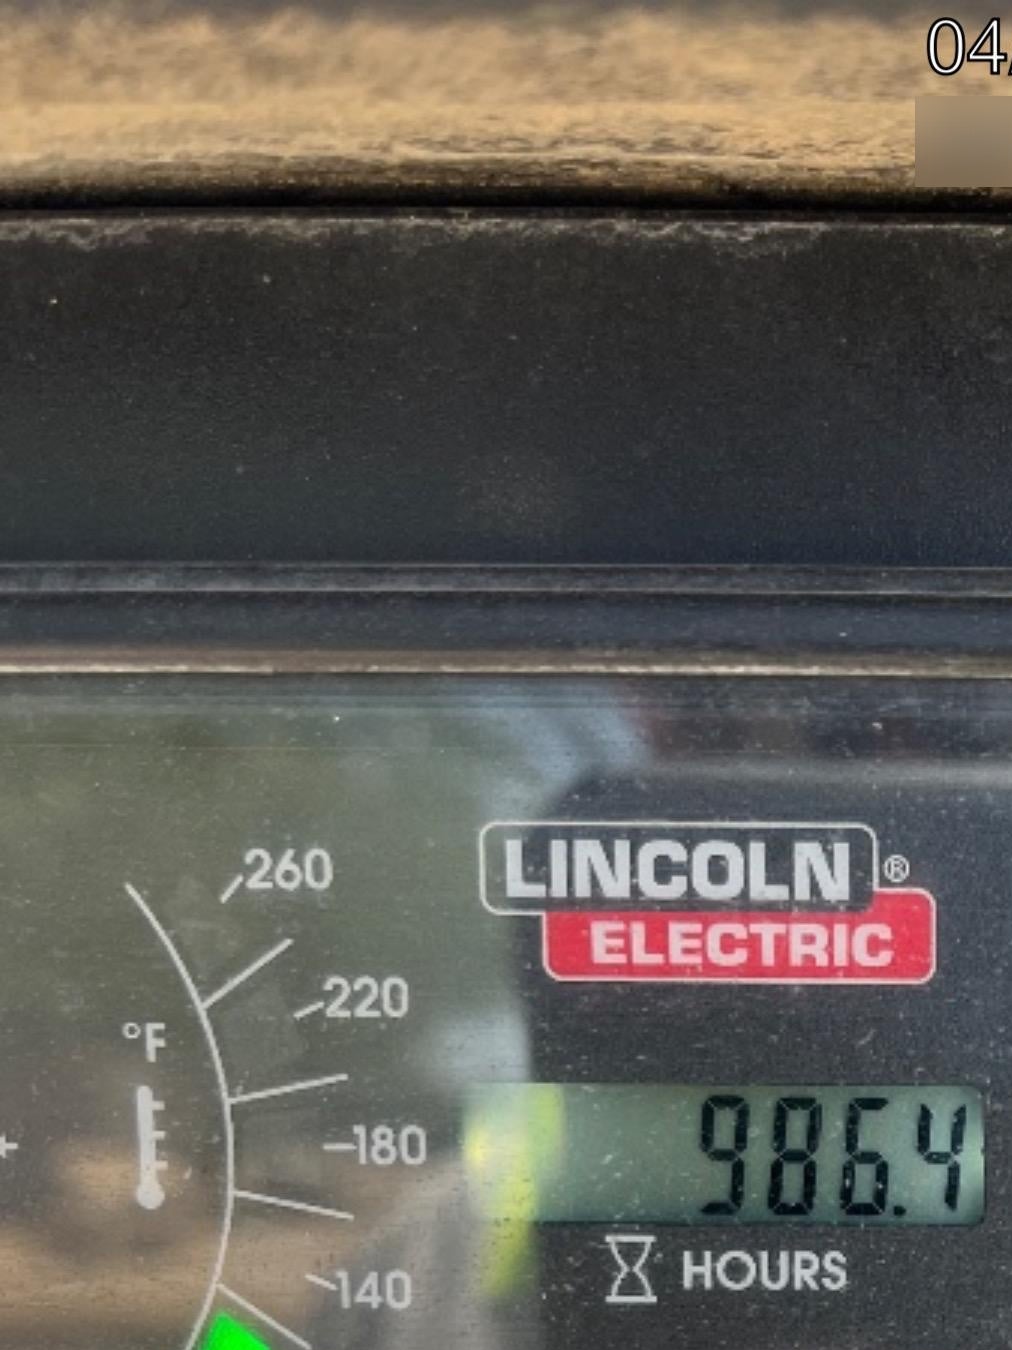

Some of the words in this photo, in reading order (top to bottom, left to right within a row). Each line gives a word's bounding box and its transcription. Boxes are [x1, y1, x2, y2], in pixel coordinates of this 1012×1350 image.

[244, 848, 333, 891] 260
[505, 839, 850, 901] LINCOLN
[590, 921, 894, 967] ELECTRIC
[323, 976, 409, 1019] 220
[353, 1125, 427, 1165] 180
[700, 1095, 966, 1216] 986.4
[335, 1271, 411, 1309] 140
[682, 1250, 847, 1291] HOURS
